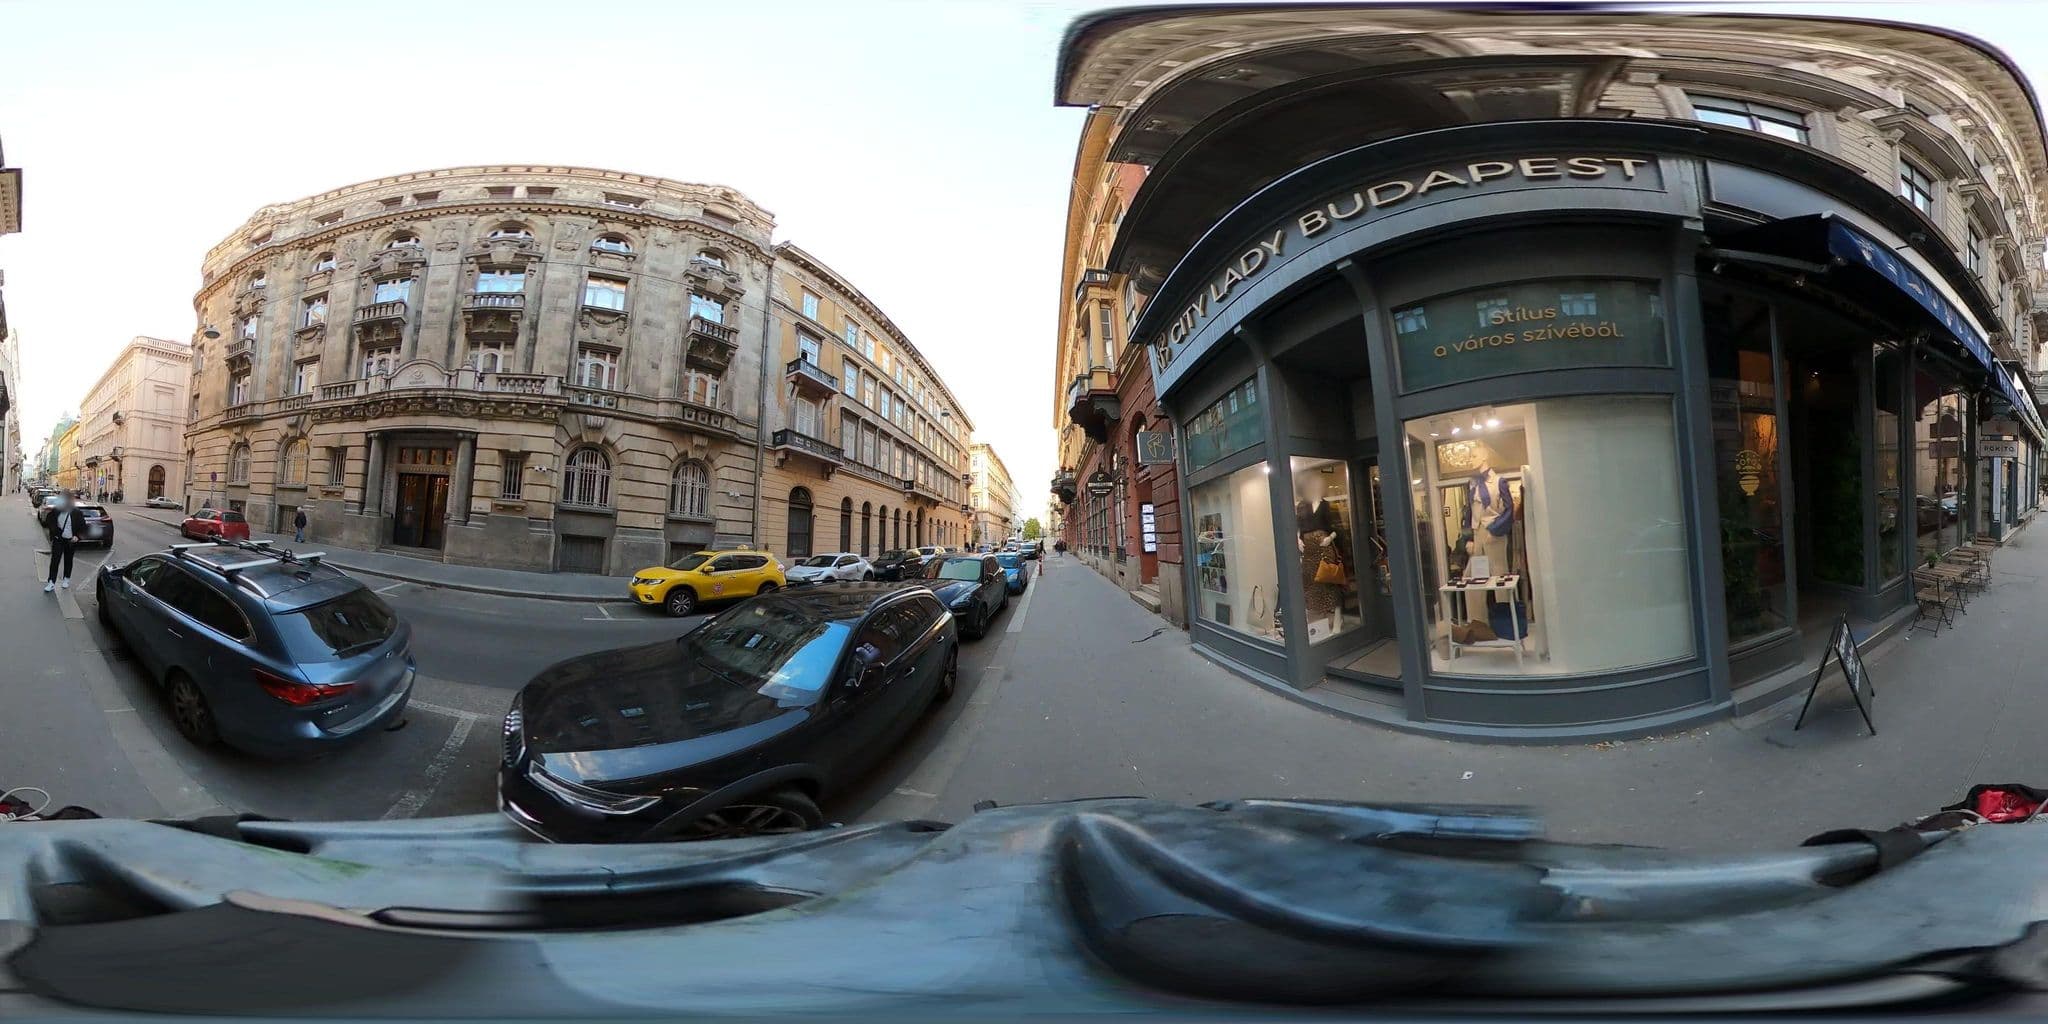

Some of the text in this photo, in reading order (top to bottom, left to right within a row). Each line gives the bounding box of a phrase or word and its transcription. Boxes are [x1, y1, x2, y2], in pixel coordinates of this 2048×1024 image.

[1170, 157, 1648, 345] CITY LADY BUDAPEST
[1491, 306, 1557, 325] Stílus
[1433, 321, 1625, 358] a város szívéből.
